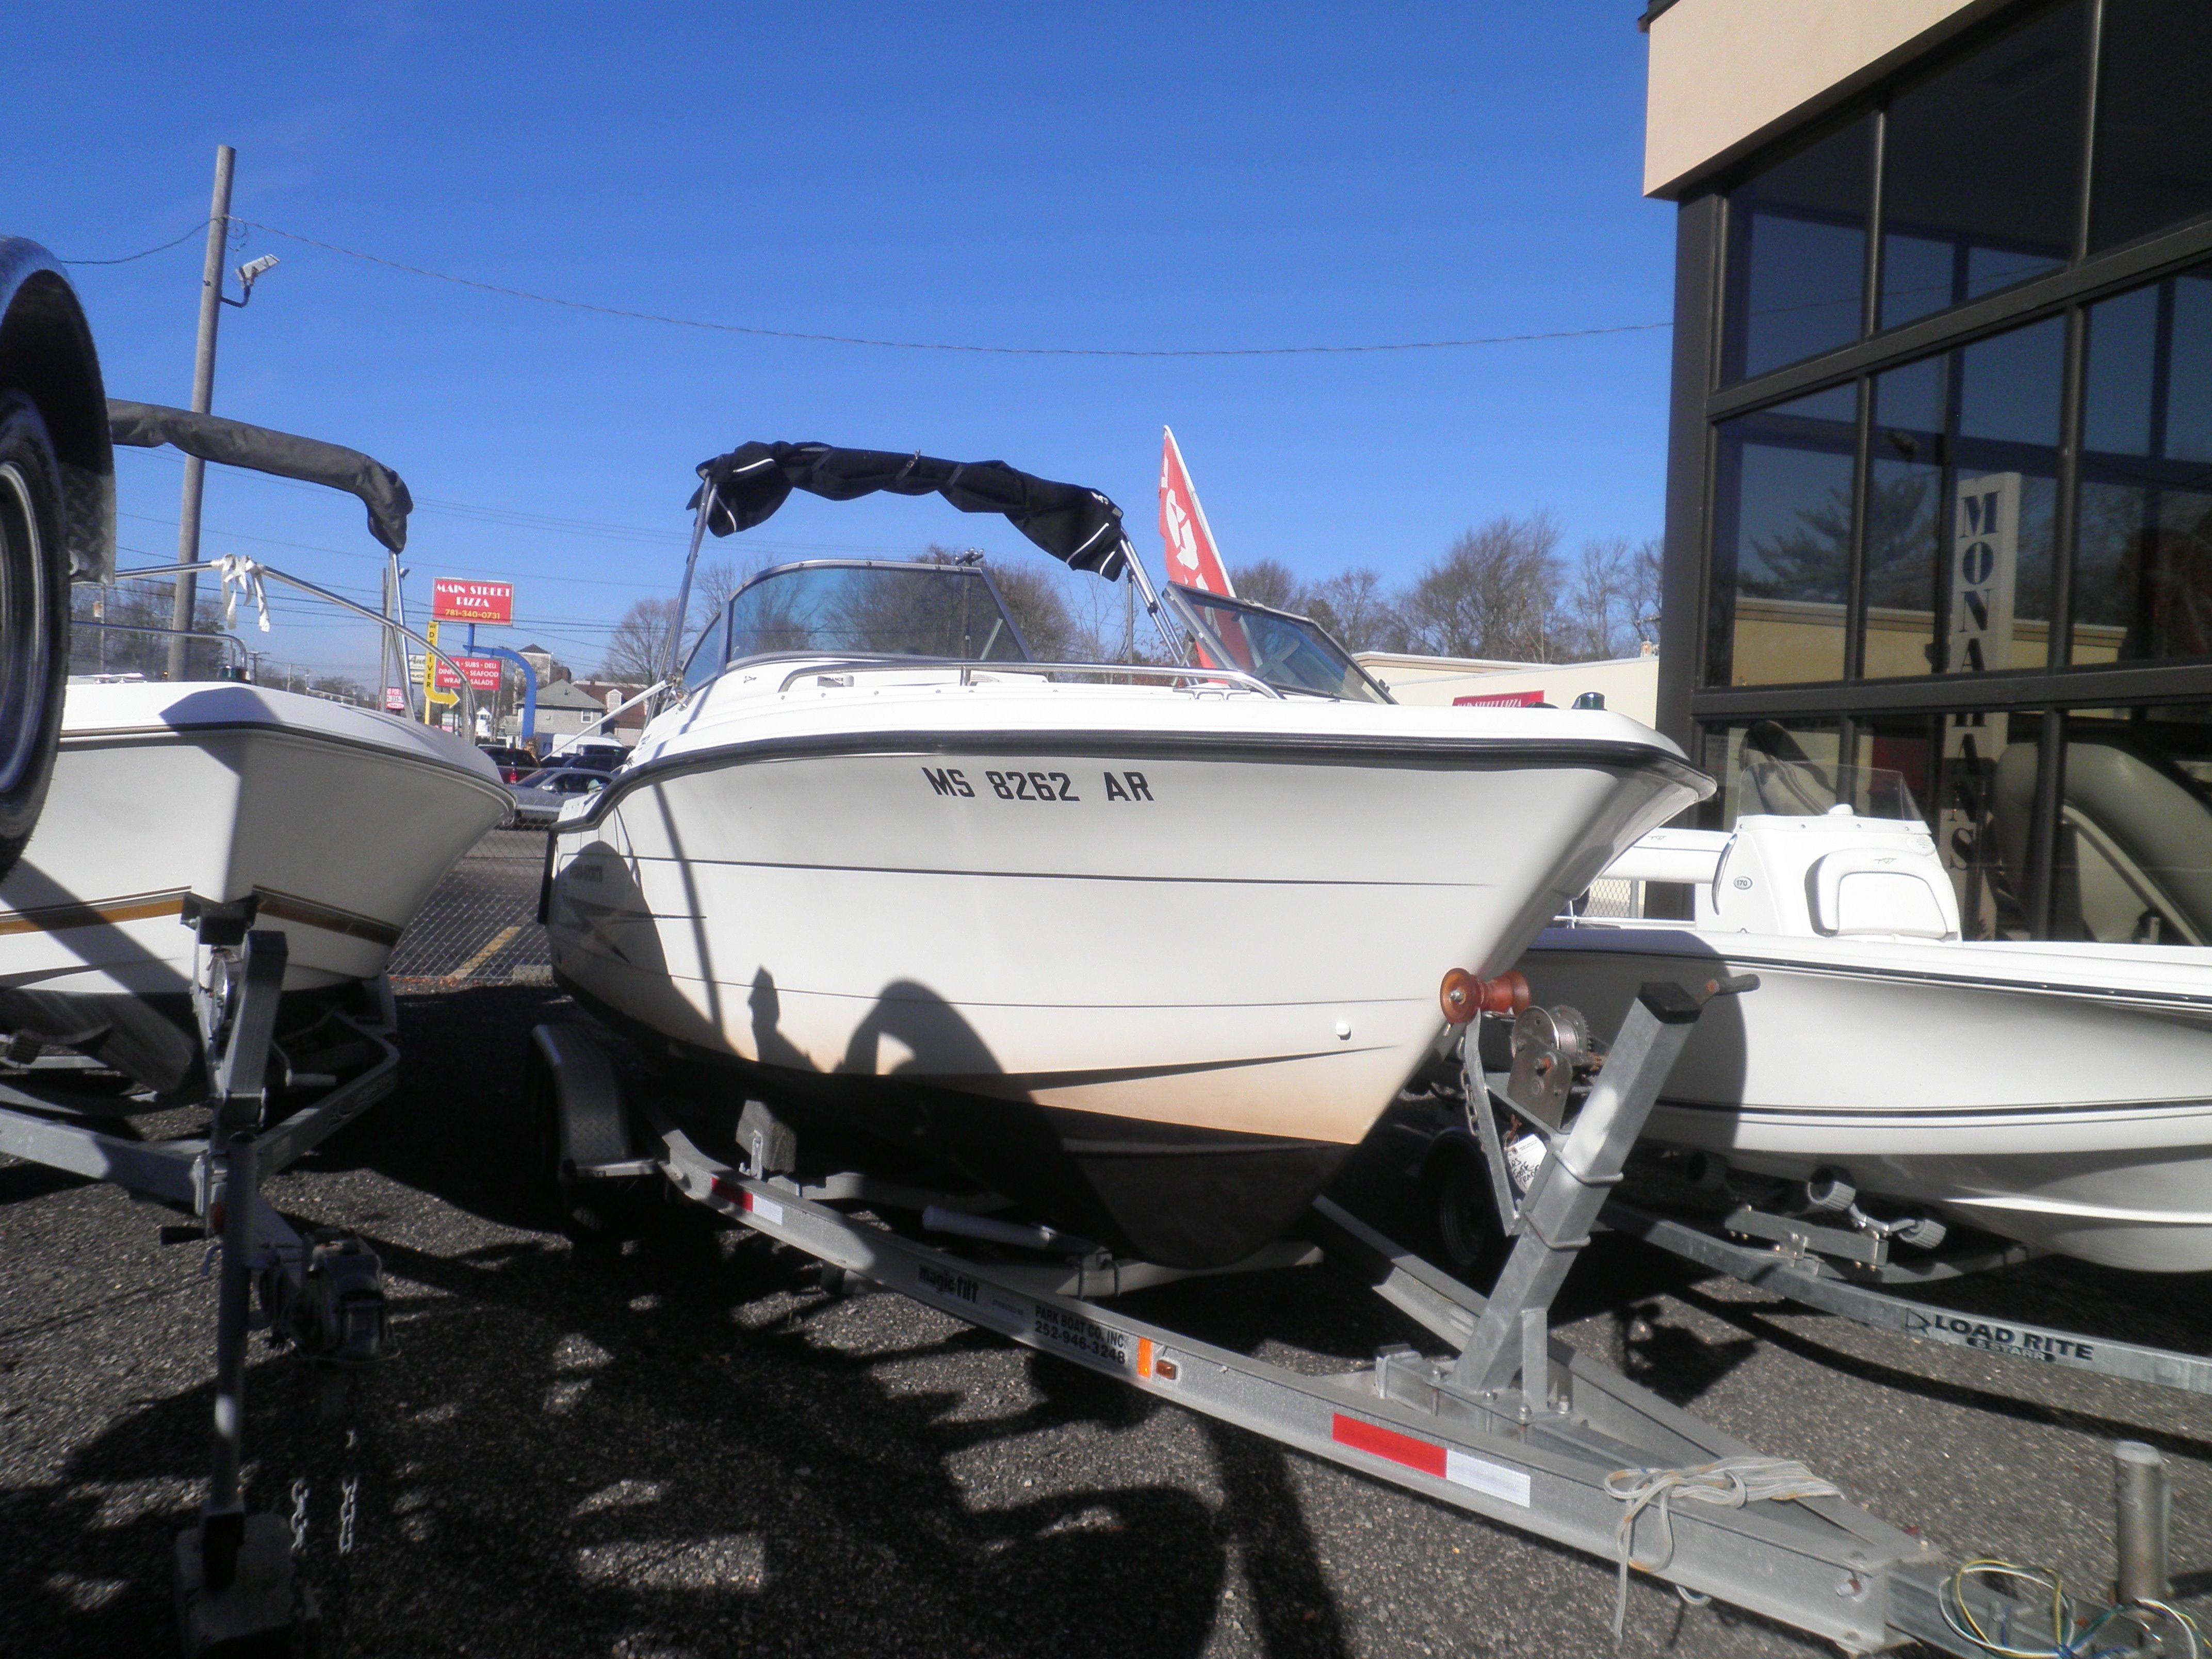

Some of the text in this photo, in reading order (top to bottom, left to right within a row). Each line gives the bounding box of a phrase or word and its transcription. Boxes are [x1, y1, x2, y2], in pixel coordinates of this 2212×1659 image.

[437, 583, 511, 597] MAIN STREET
[456, 596, 490, 607] PIZZA
[445, 608, 500, 619] 781-340-0731
[426, 631, 435, 688] DEIVER
[921, 767, 1155, 802] MS 8262 AR
[1035, 1305, 1058, 1324] PARK
[1061, 1314, 1086, 1334] BOAT
[1035, 1321, 1126, 1364] 252-946-3248
[1935, 1315, 2093, 1361] LOAD RITE
